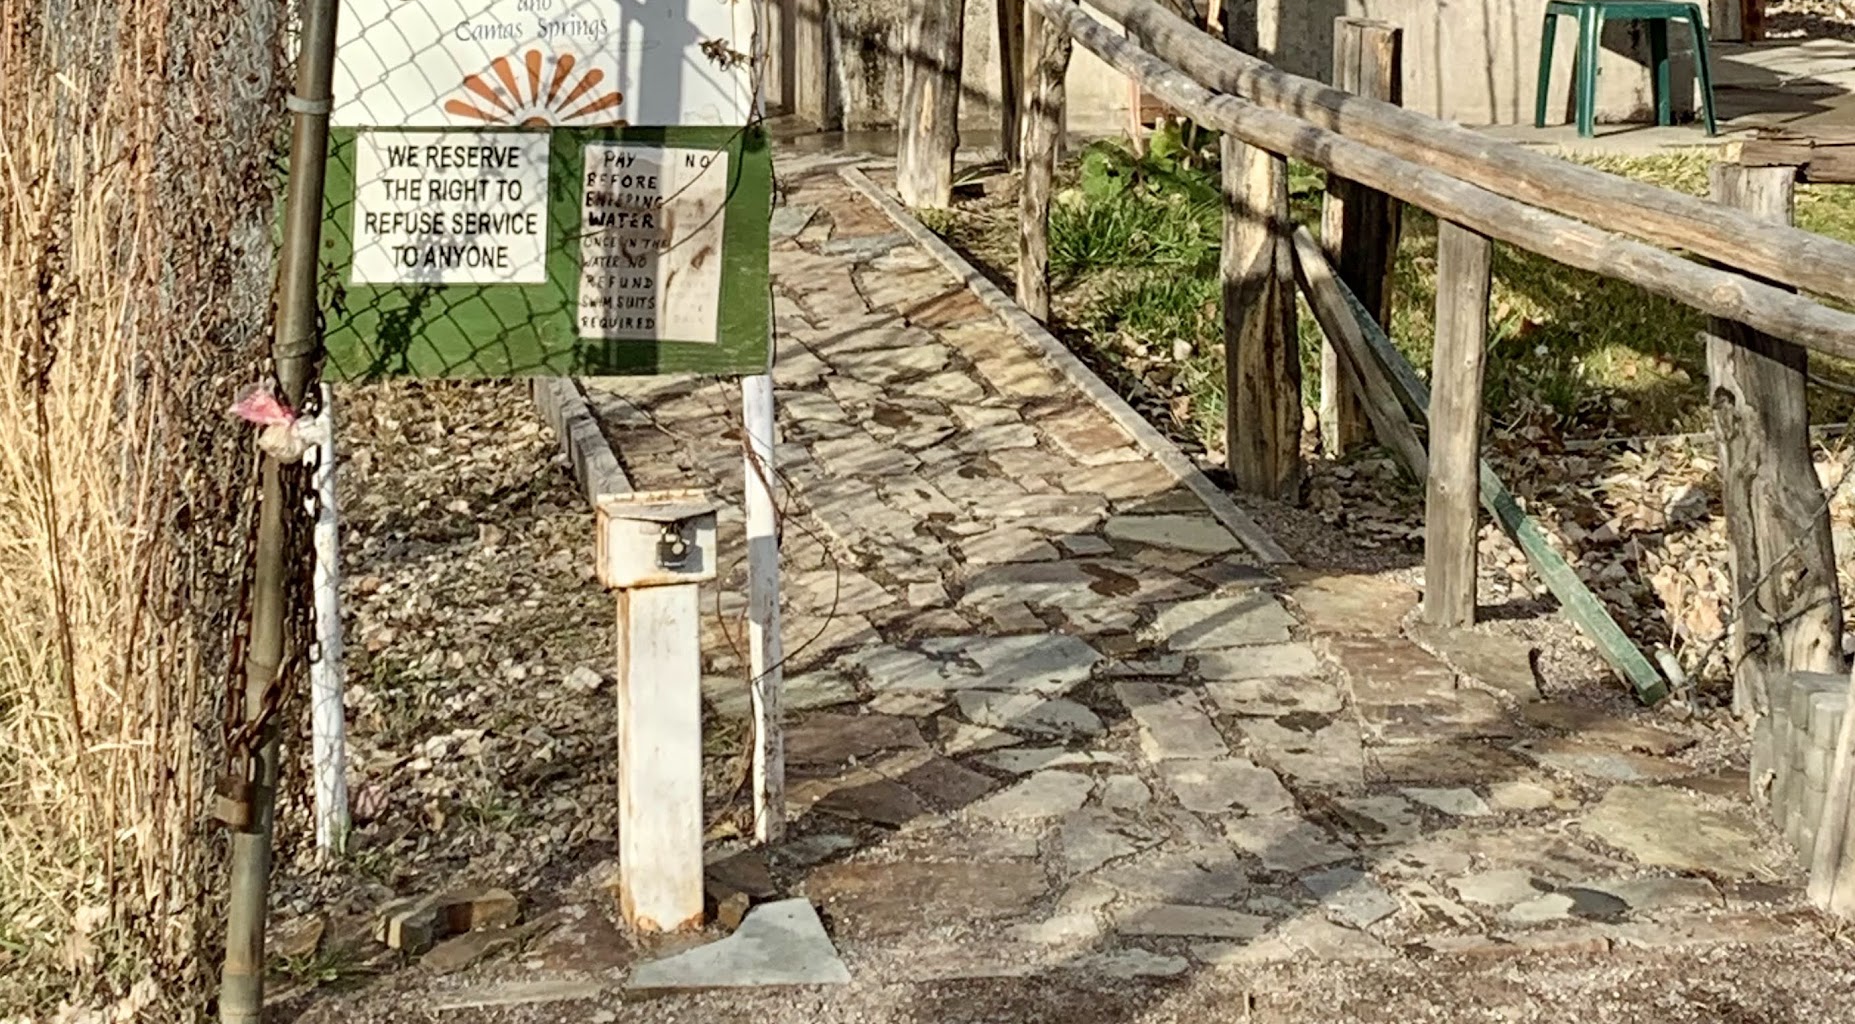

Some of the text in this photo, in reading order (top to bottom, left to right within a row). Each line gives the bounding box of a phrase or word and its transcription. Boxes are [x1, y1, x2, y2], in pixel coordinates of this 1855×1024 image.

[454, 13, 608, 42] Camas Springs
[388, 145, 520, 169] WE RESERVE
[604, 150, 637, 169] PAY
[685, 153, 711, 169] NO
[382, 179, 522, 202] THE RIGHT TO
[587, 172, 657, 189] BEFORE
[365, 212, 538, 235] REFUSE SERVICE
[588, 211, 654, 228] WATER
[392, 246, 508, 269] TO ANYONE
